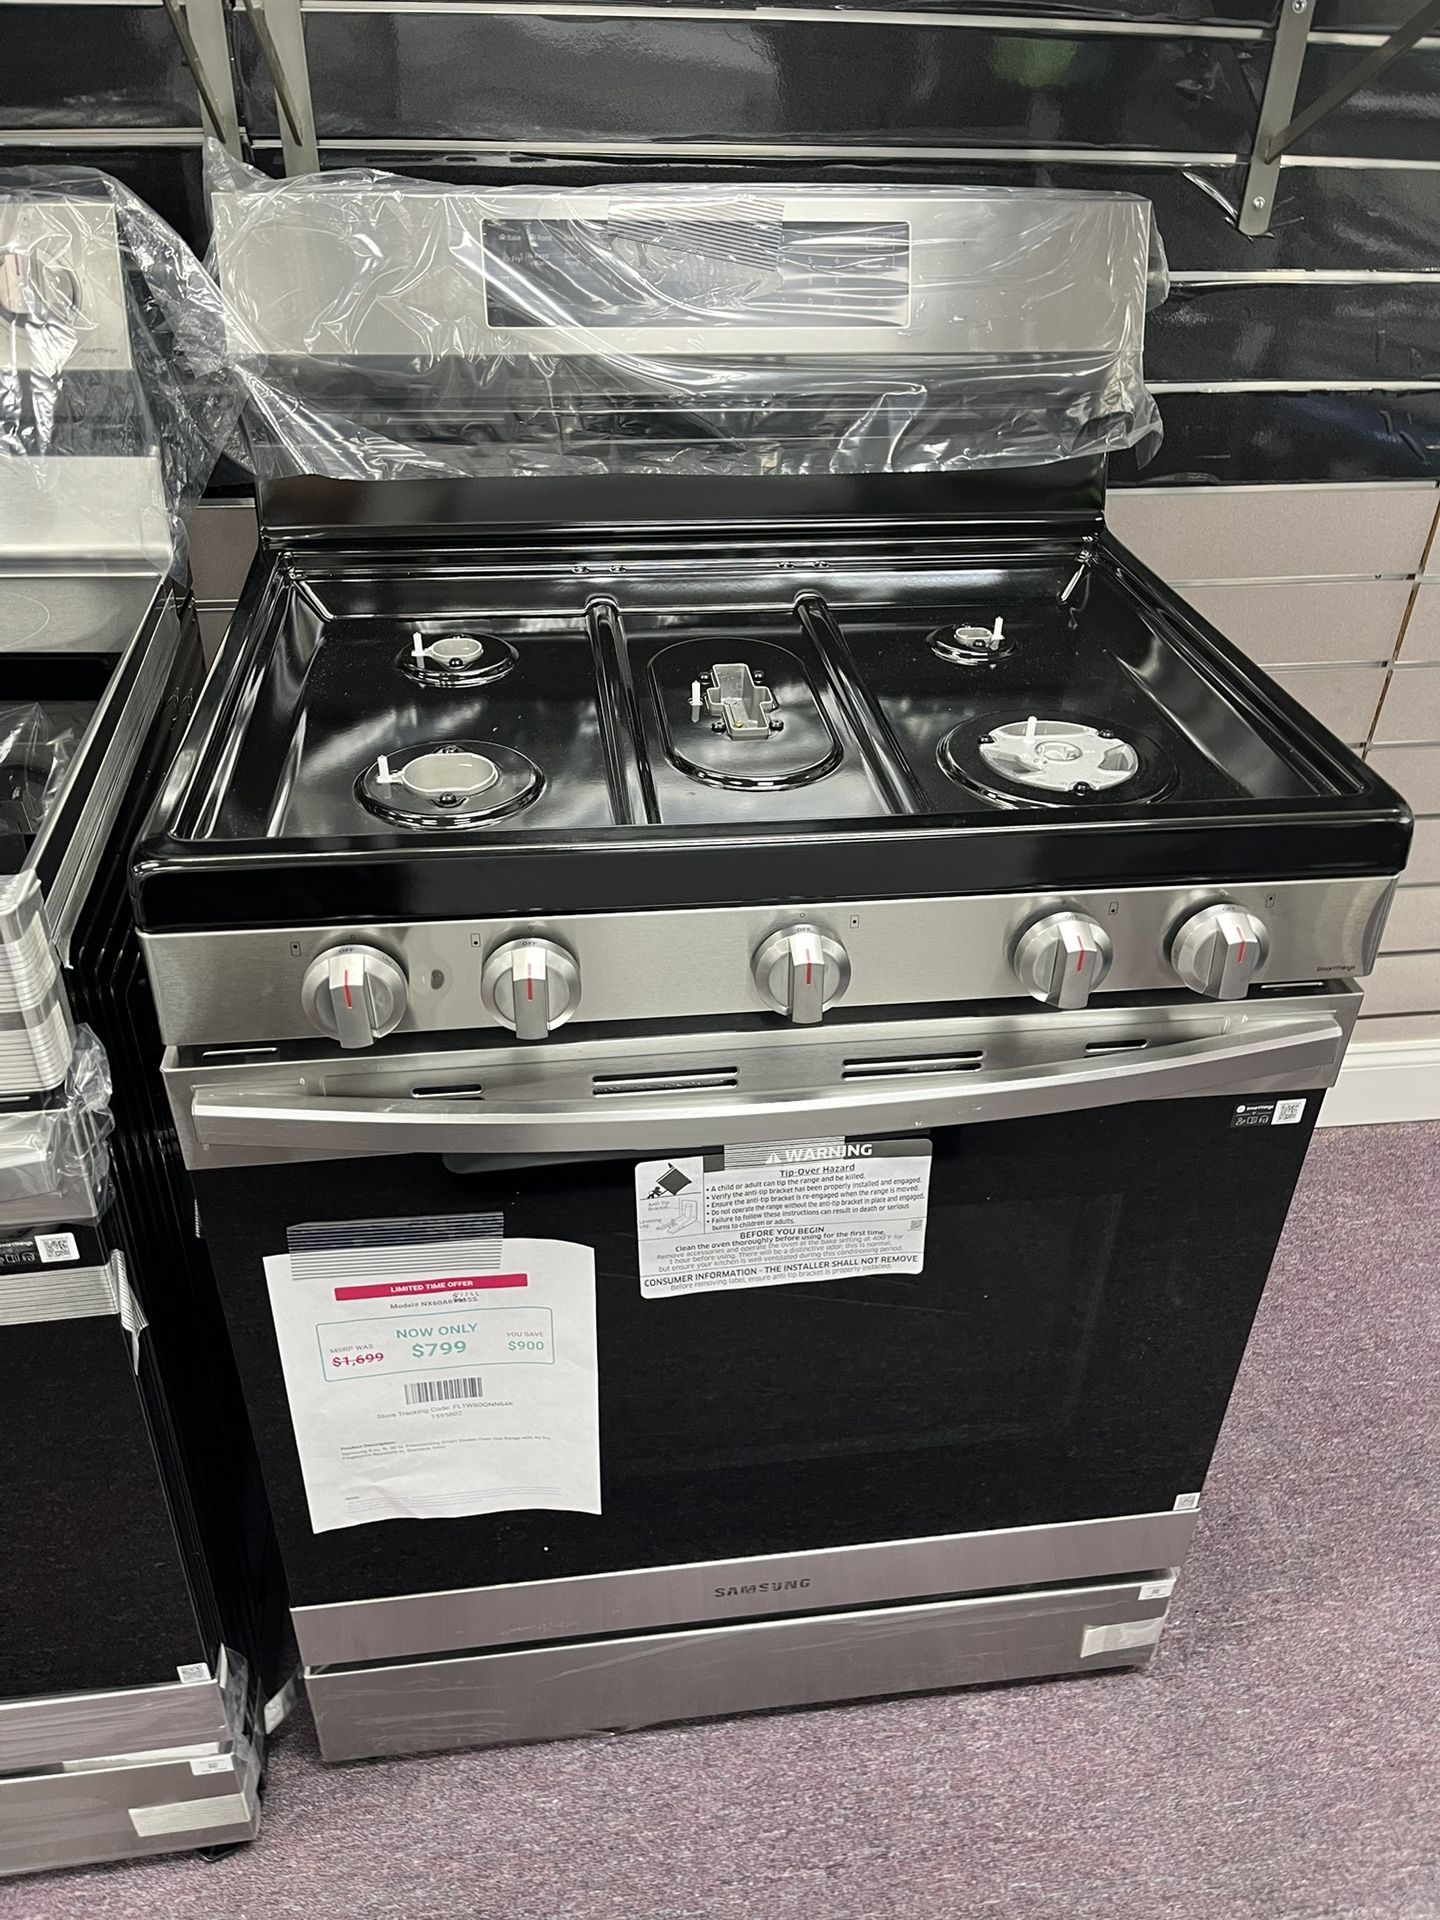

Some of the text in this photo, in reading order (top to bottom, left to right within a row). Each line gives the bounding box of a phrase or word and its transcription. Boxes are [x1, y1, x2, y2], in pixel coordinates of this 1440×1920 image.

[785, 1143, 873, 1162] WARNING
[779, 1163, 856, 1178] Tip-Over Hazard
[710, 1192, 731, 1200] Verify
[744, 1189, 768, 1198] anti-tip
[768, 1186, 794, 1194] bracket
[823, 1182, 850, 1191] properly
[852, 1179, 879, 1187] installed
[893, 1176, 922, 1185] engaged.
[717, 1183, 734, 1191] child
[776, 1179, 786, 1187] tip
[800, 1176, 820, 1185] range
[730, 1206, 754, 1215] operate
[765, 1203, 784, 1212] range
[784, 1201, 807, 1209] without
[818, 1199, 840, 1208] anti-tip
[870, 1195, 886, 1203] place
[898, 1192, 926, 1201] engaged.
[745, 1196, 770, 1206] anti-tip
[770, 1194, 795, 1202] bracket
[802, 1191, 839, 1201] re-engaged
[870, 1187, 889, 1195] range
[896, 1184, 920, 1192] moved.
[711, 1215, 734, 1223] Failure
[742, 1213, 762, 1221] follow
[763, 1211, 782, 1219] these
[782, 1208, 820, 1217] instructions
[886, 1201, 910, 1209] serious
[739, 1220, 764, 1228] children
[740, 1225, 824, 1239] BEFORE YOU BEGIN
[675, 1244, 696, 1252] Clean
[732, 1238, 774, 1248] thoroughly
[774, 1235, 800, 1243] before
[800, 1234, 822, 1242] using
[867, 1228, 886, 1236] time.
[644, 1253, 918, 1287] CONSUMER INFORMATION THE INSTALLER SHALL NOT REMOVE
[390, 1280, 474, 1293] LIMITED TIME OFFER
[396, 1322, 478, 1339] NOW ONLY
[330, 1343, 374, 1354] MSRP WAS
[412, 1340, 467, 1358] $799
[508, 1340, 544, 1351] $900
[332, 1352, 384, 1368] $1,699
[398, 1408, 429, 1417] Tracking
[714, 1578, 811, 1598] SAMSUNG
